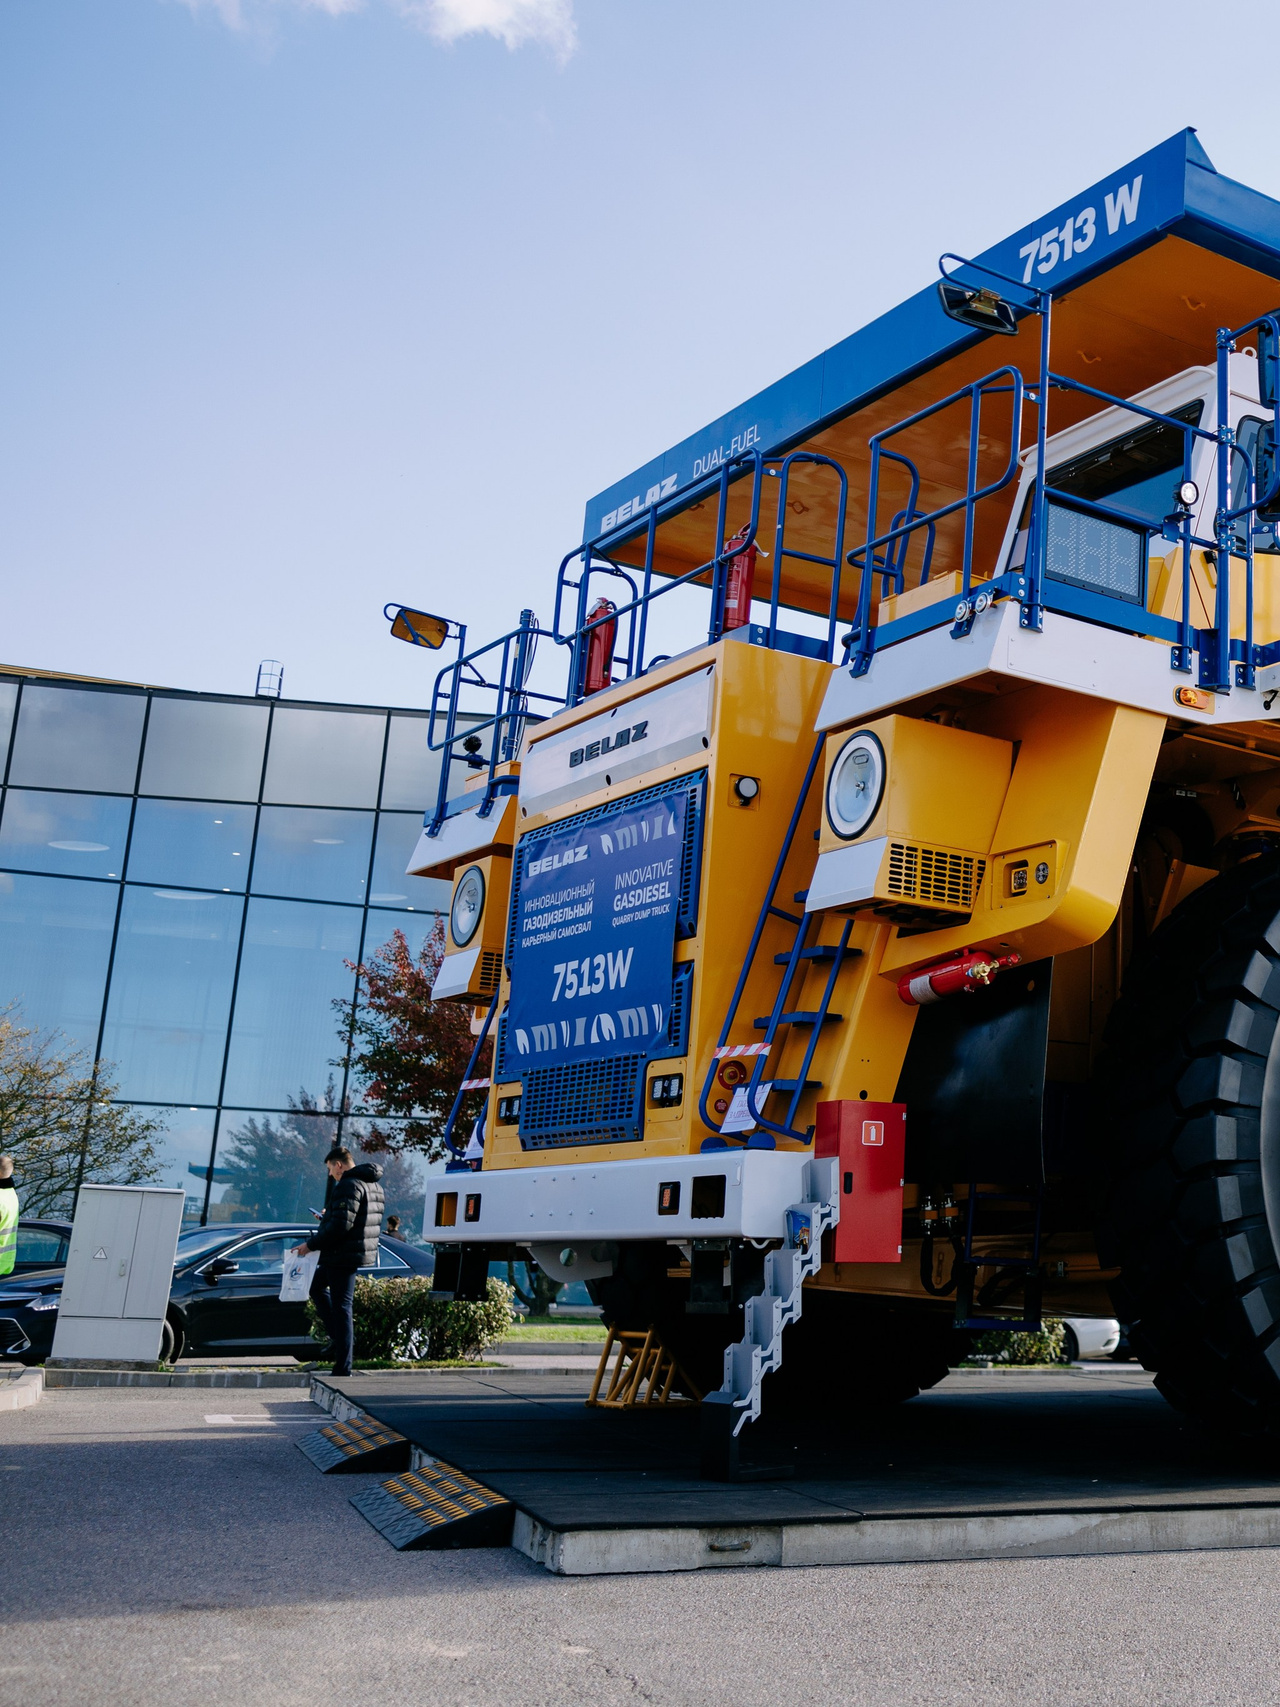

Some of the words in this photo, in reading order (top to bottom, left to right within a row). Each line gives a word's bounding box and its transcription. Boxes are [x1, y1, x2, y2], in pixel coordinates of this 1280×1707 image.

[1019, 206, 1097, 285] 7513
[1103, 174, 1143, 236] W
[600, 472, 678, 534] BELAZ
[692, 424, 761, 479] DUAL-FUEL
[568, 720, 649, 768] BELAZ
[528, 844, 589, 878] BELAZ
[614, 858, 674, 890] INNOVATIVE
[524, 878, 595, 913] ИННОВАЦИОННЫЙ
[613, 881, 671, 912] GASDIESEL
[522, 899, 594, 932] ГАЗОДИЗЕЛЬНЫЙ
[612, 912, 635, 928] QUARRY
[634, 908, 651, 922] DUMP
[651, 903, 671, 918] TRUCK
[521, 928, 557, 948] КАРЬЕРНЫЙ
[557, 921, 592, 940] САМОСВАЛ
[551, 946, 635, 1003] 7513W
